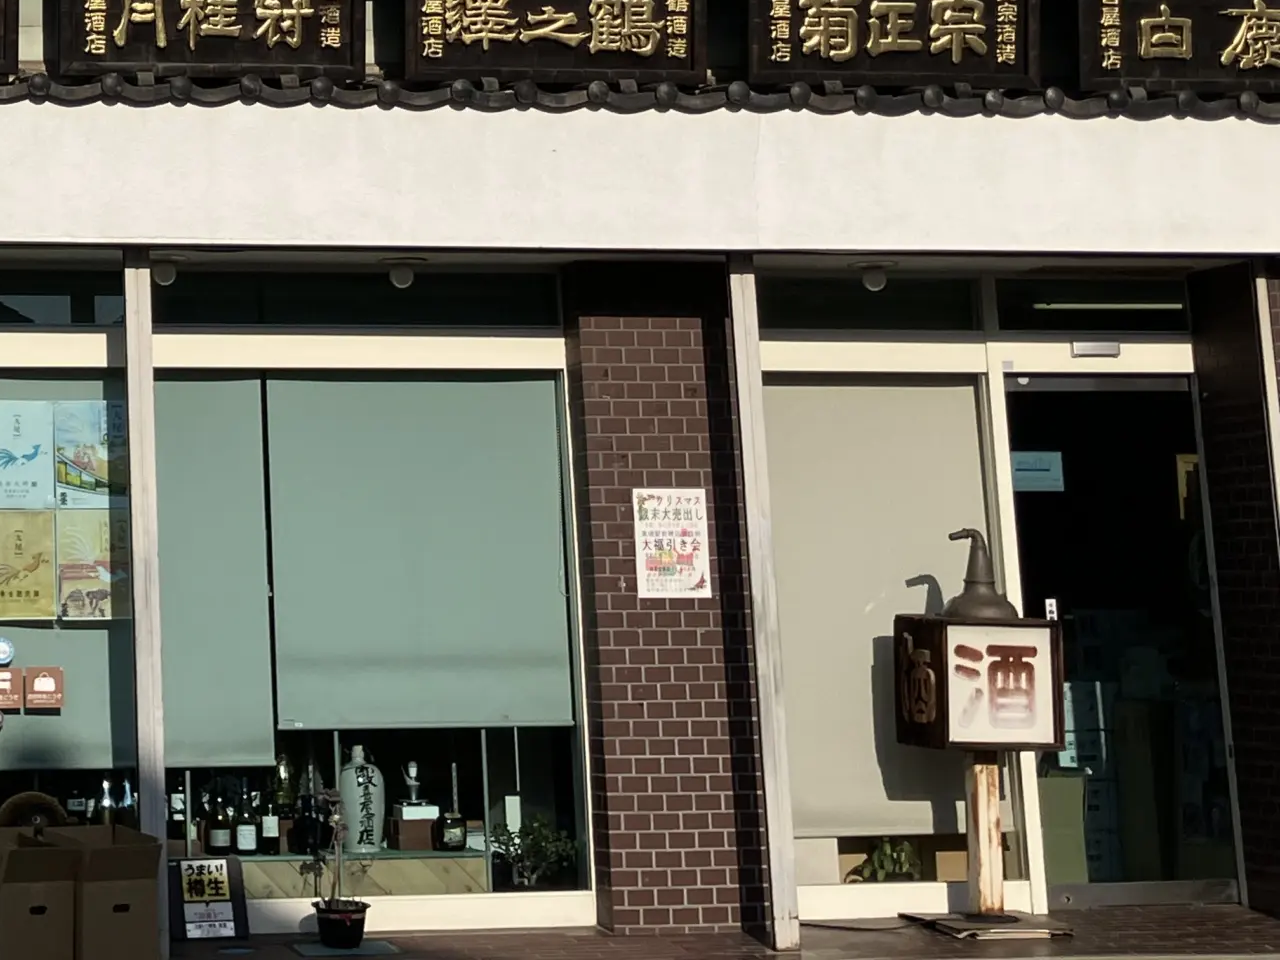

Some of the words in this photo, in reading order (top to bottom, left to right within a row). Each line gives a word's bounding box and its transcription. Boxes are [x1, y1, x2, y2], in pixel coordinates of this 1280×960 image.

[655, 495, 701, 506] クリスマス
[954, 644, 1038, 729] 酒
